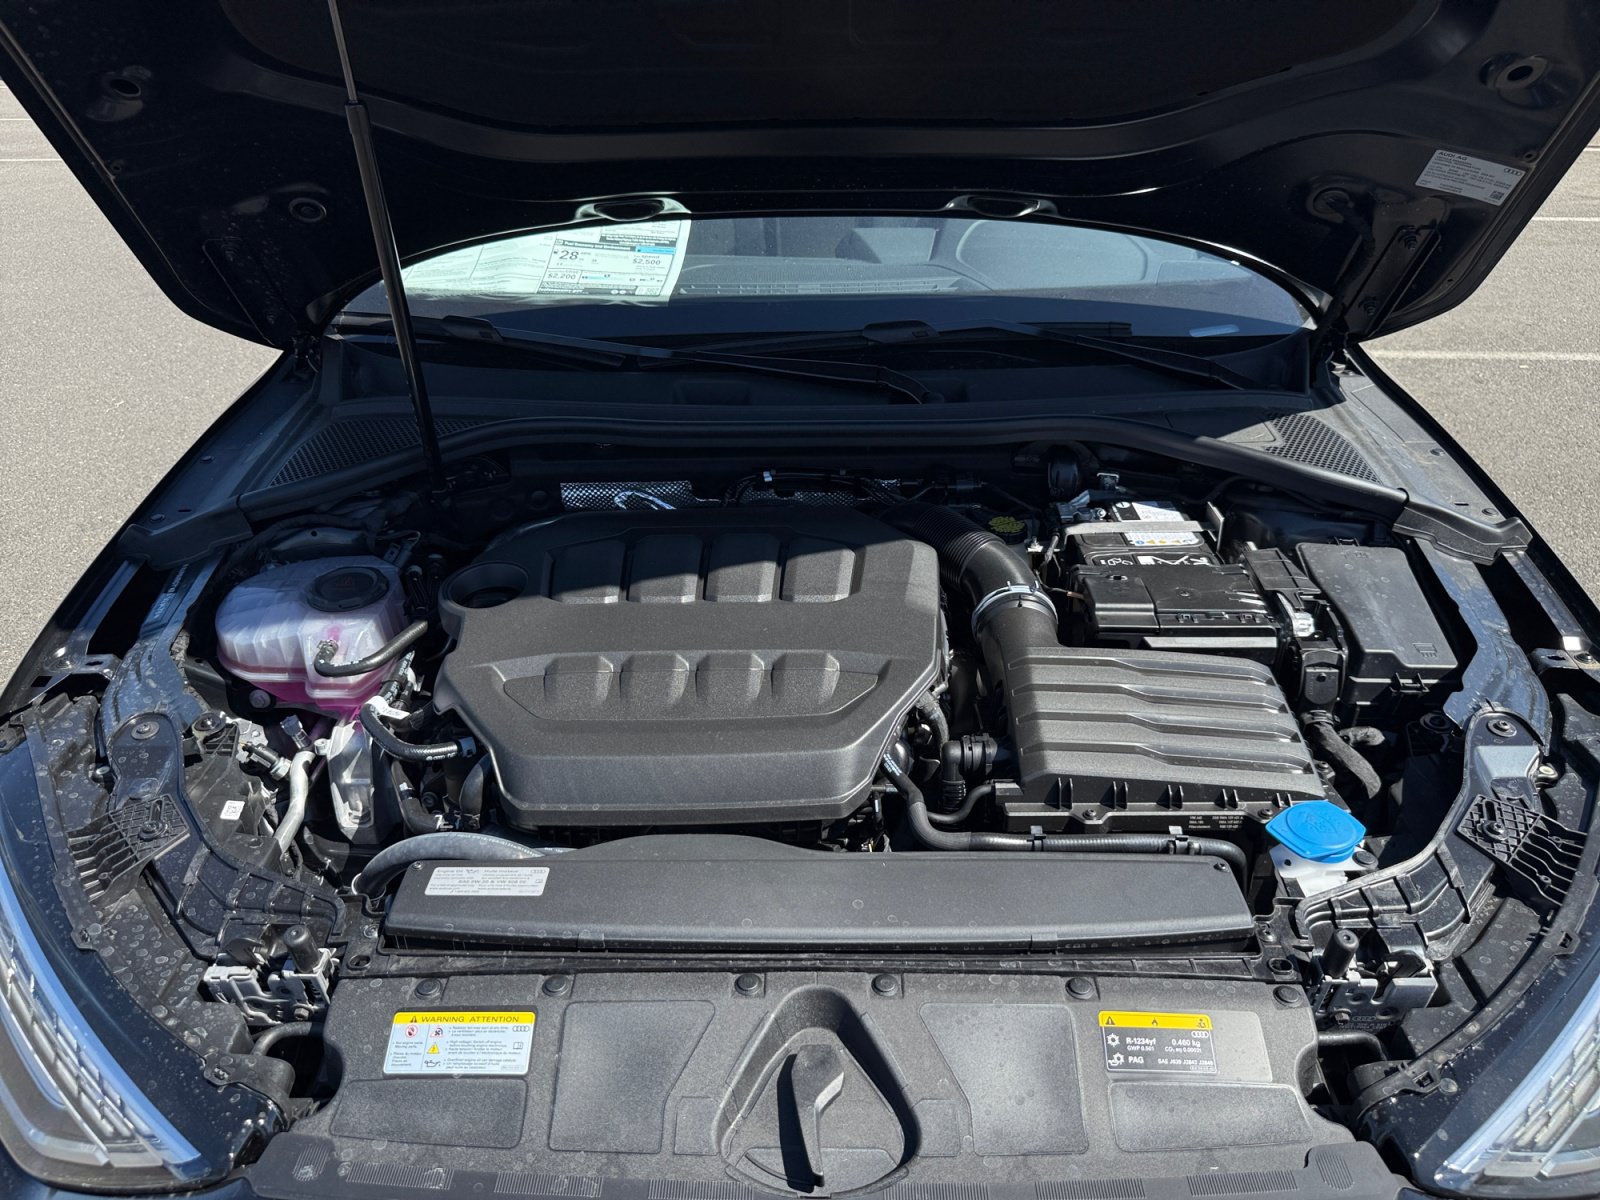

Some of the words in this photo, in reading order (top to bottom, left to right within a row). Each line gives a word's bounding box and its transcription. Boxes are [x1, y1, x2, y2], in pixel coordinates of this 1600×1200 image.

[559, 250, 579, 260] 28
[547, 272, 576, 280] $2,200
[421, 1015, 465, 1023] WARNING
[469, 1015, 520, 1023] ATTENTION
[1126, 1037, 1156, 1046] R-1234yf
[1128, 1056, 1144, 1064] PAG
